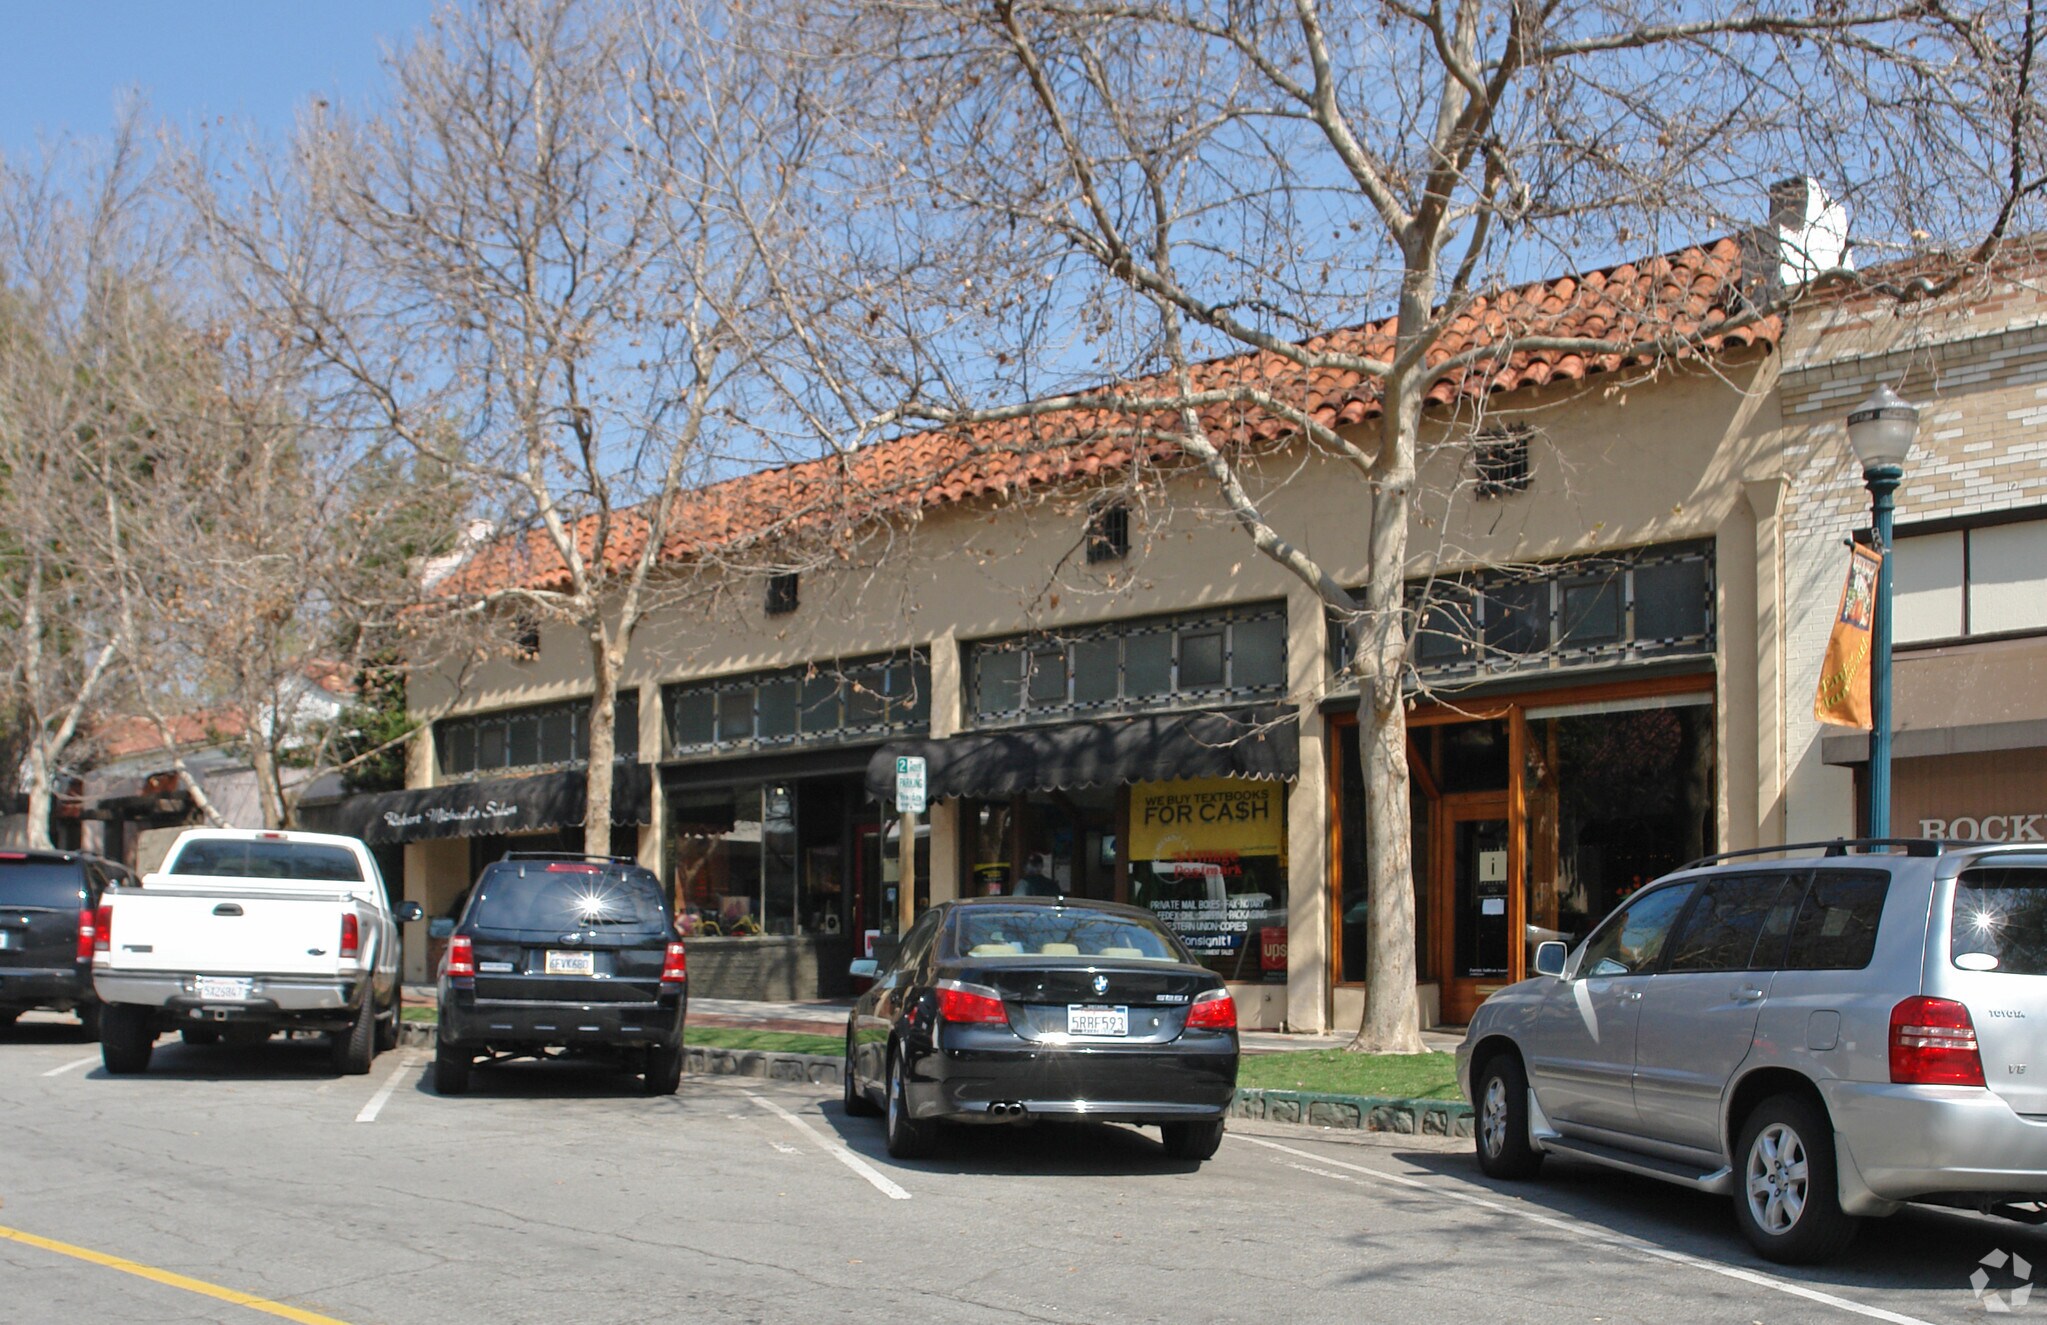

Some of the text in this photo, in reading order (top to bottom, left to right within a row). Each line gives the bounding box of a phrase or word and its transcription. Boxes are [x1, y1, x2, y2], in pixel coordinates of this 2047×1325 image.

[898, 760, 907, 773] 2
[899, 778, 923, 789] PARKING
[1145, 789, 1269, 806] WE BUY TEXTBOOKS
[481, 800, 518, 818] Salon
[1144, 804, 1193, 825] FOR
[1919, 814, 2047, 842] ROCK
[1173, 864, 1243, 879] Postmark
[1150, 899, 1179, 909] PRIVATE
[1181, 899, 1197, 909] MAIL
[1198, 899, 1220, 909] BOXES
[1165, 921, 1248, 932] ESTERN UNION COPIES
[1263, 943, 1288, 961] ups
[1988, 1009, 2026, 1018] TOYOTA
[2008, 1064, 2027, 1075] V6
